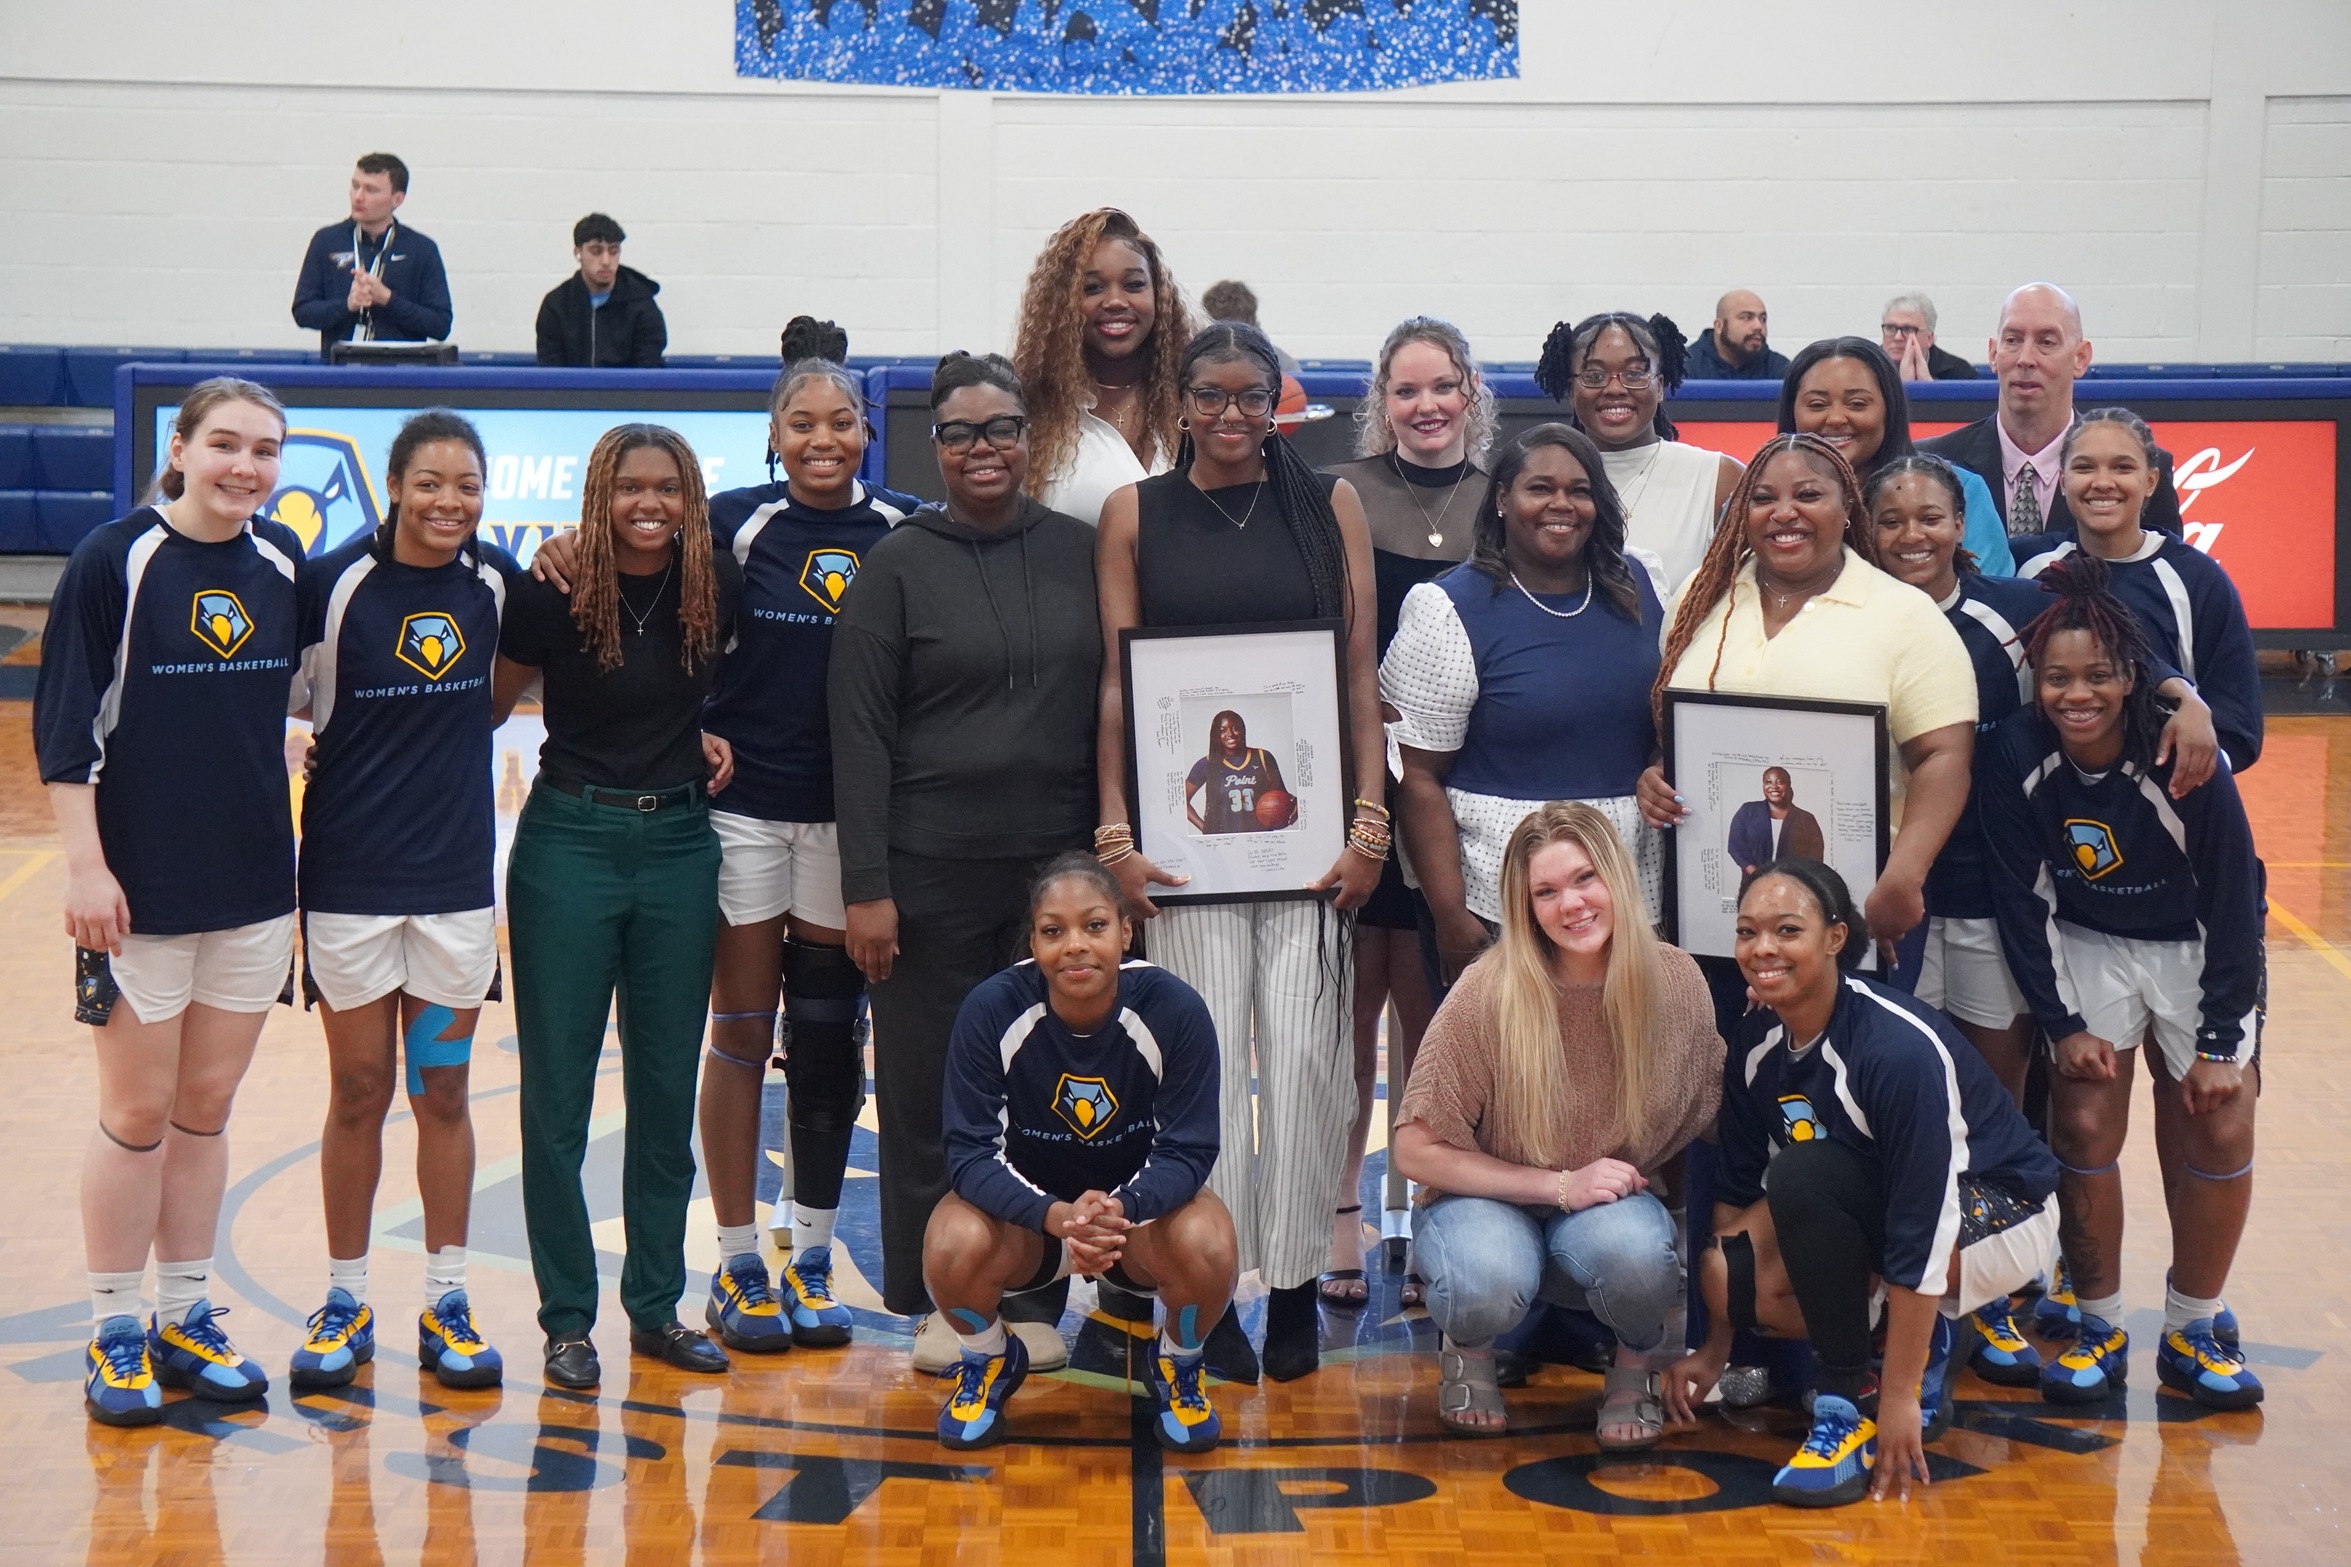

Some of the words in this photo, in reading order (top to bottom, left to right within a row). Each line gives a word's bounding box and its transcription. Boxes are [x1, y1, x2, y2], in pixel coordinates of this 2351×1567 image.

[486, 455, 579, 500] OME
[754, 608, 818, 624] WOMEN'S
[152, 663, 214, 675] WOMEN'S
[219, 657, 289, 672] BASKETBALL
[354, 685, 418, 698] WOMEN'S
[424, 675, 486, 693] BASKETBA
[1224, 774, 1257, 787] Point
[1228, 788, 1254, 812] 33
[1014, 1120, 1073, 1141] OMEN'S
